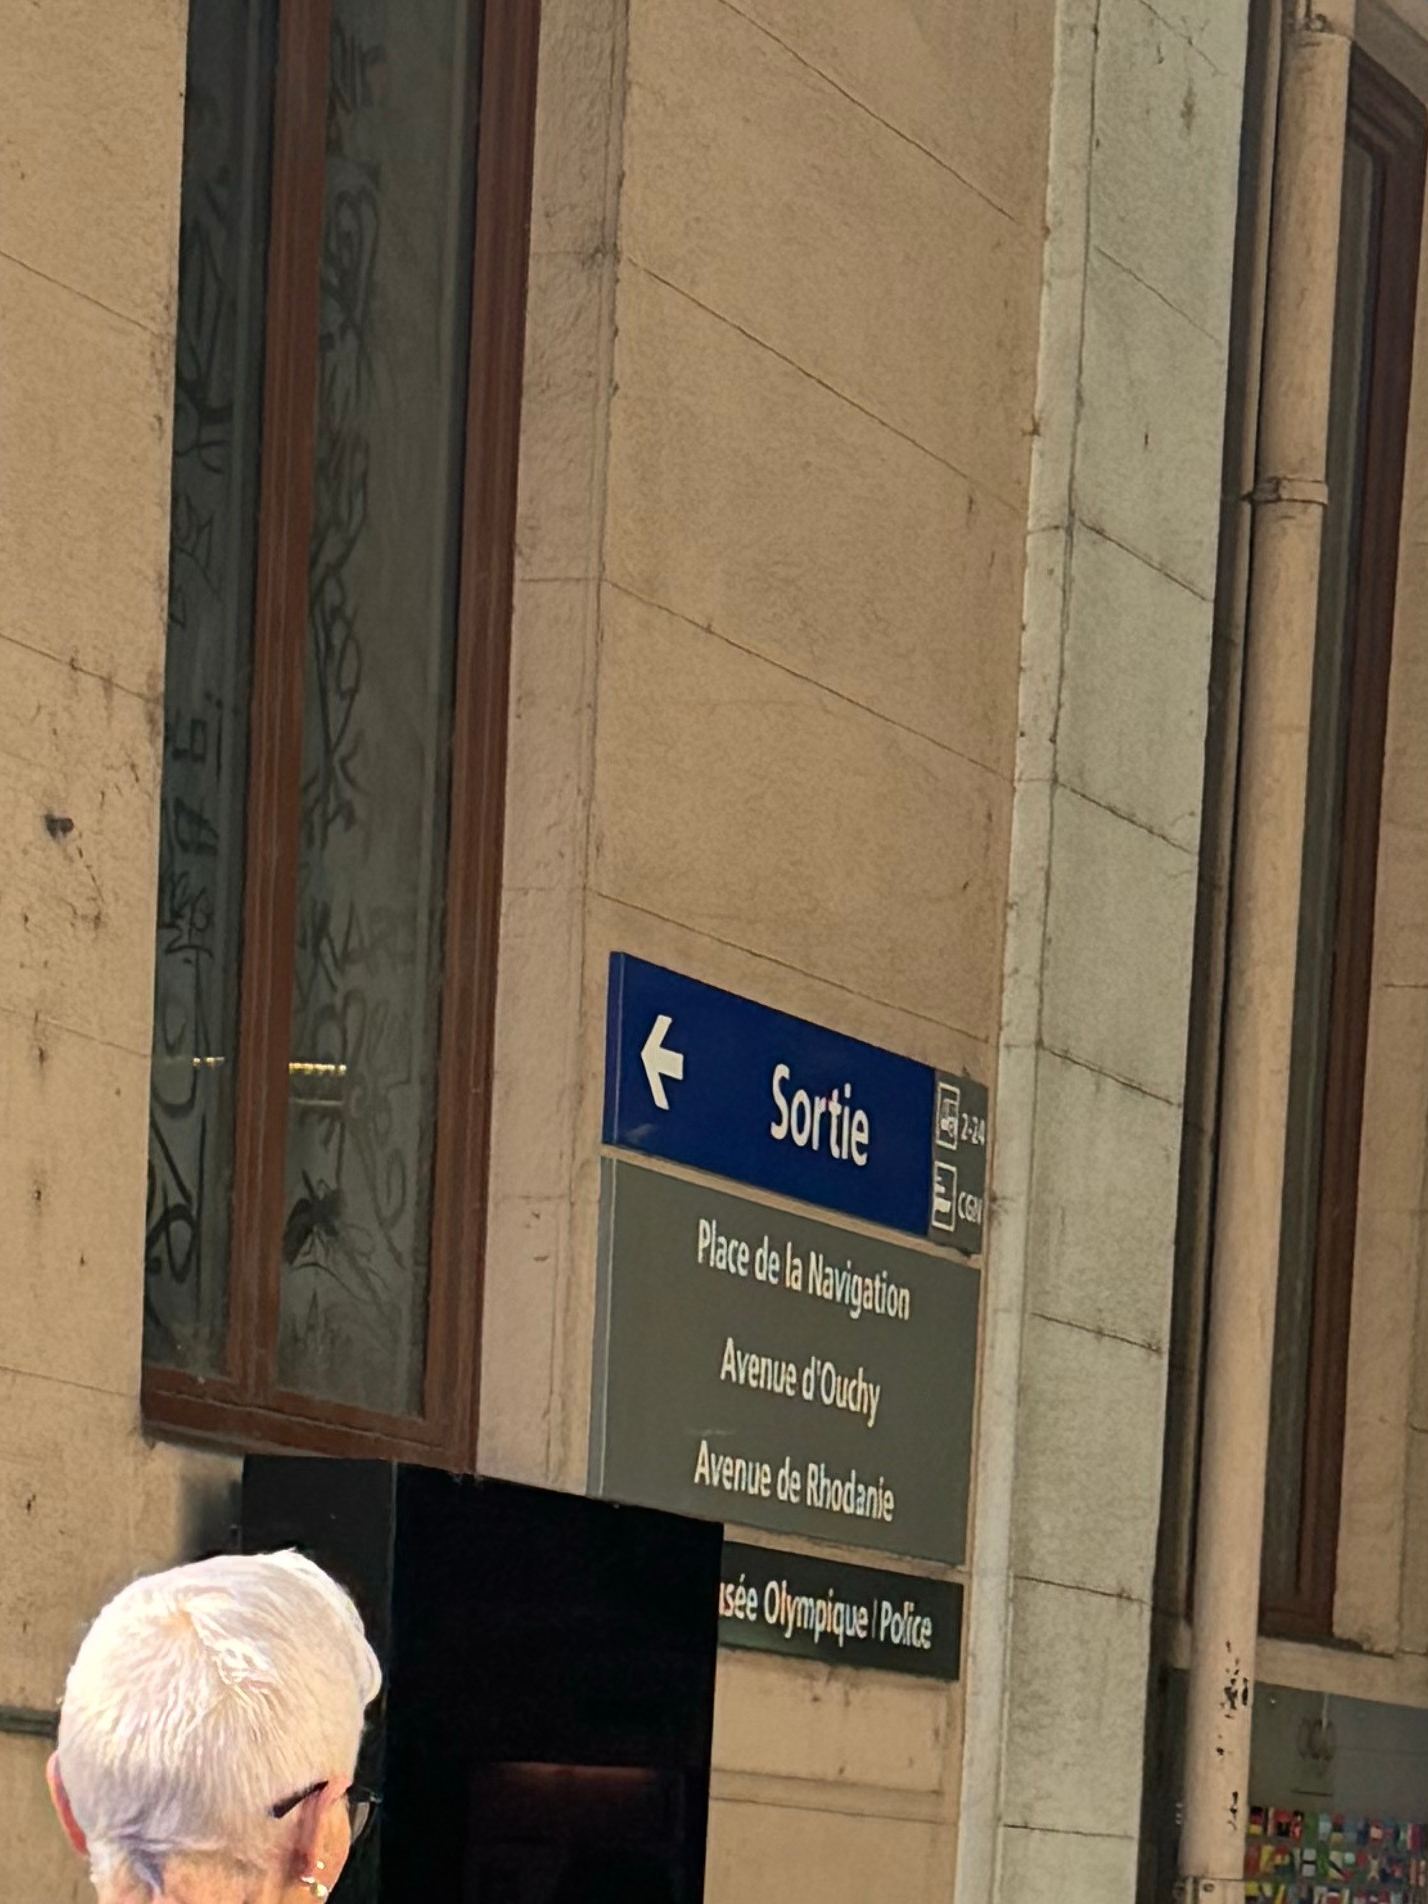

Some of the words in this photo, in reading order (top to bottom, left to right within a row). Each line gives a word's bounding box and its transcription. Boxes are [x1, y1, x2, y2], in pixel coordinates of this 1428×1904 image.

[770, 1063, 870, 1167] Sortie
[697, 1218, 750, 1277] Place
[754, 1235, 781, 1285] de
[785, 1241, 803, 1292] la
[807, 1250, 911, 1321] Navigation
[720, 1337, 798, 1396] Avenue
[801, 1355, 881, 1428] d'Ouchy
[693, 1439, 772, 1498] Avenue
[776, 1455, 802, 1504] de
[806, 1462, 896, 1523] Rhodanie
[763, 1580, 869, 1648] Olympique
[880, 1600, 933, 1650] Police
